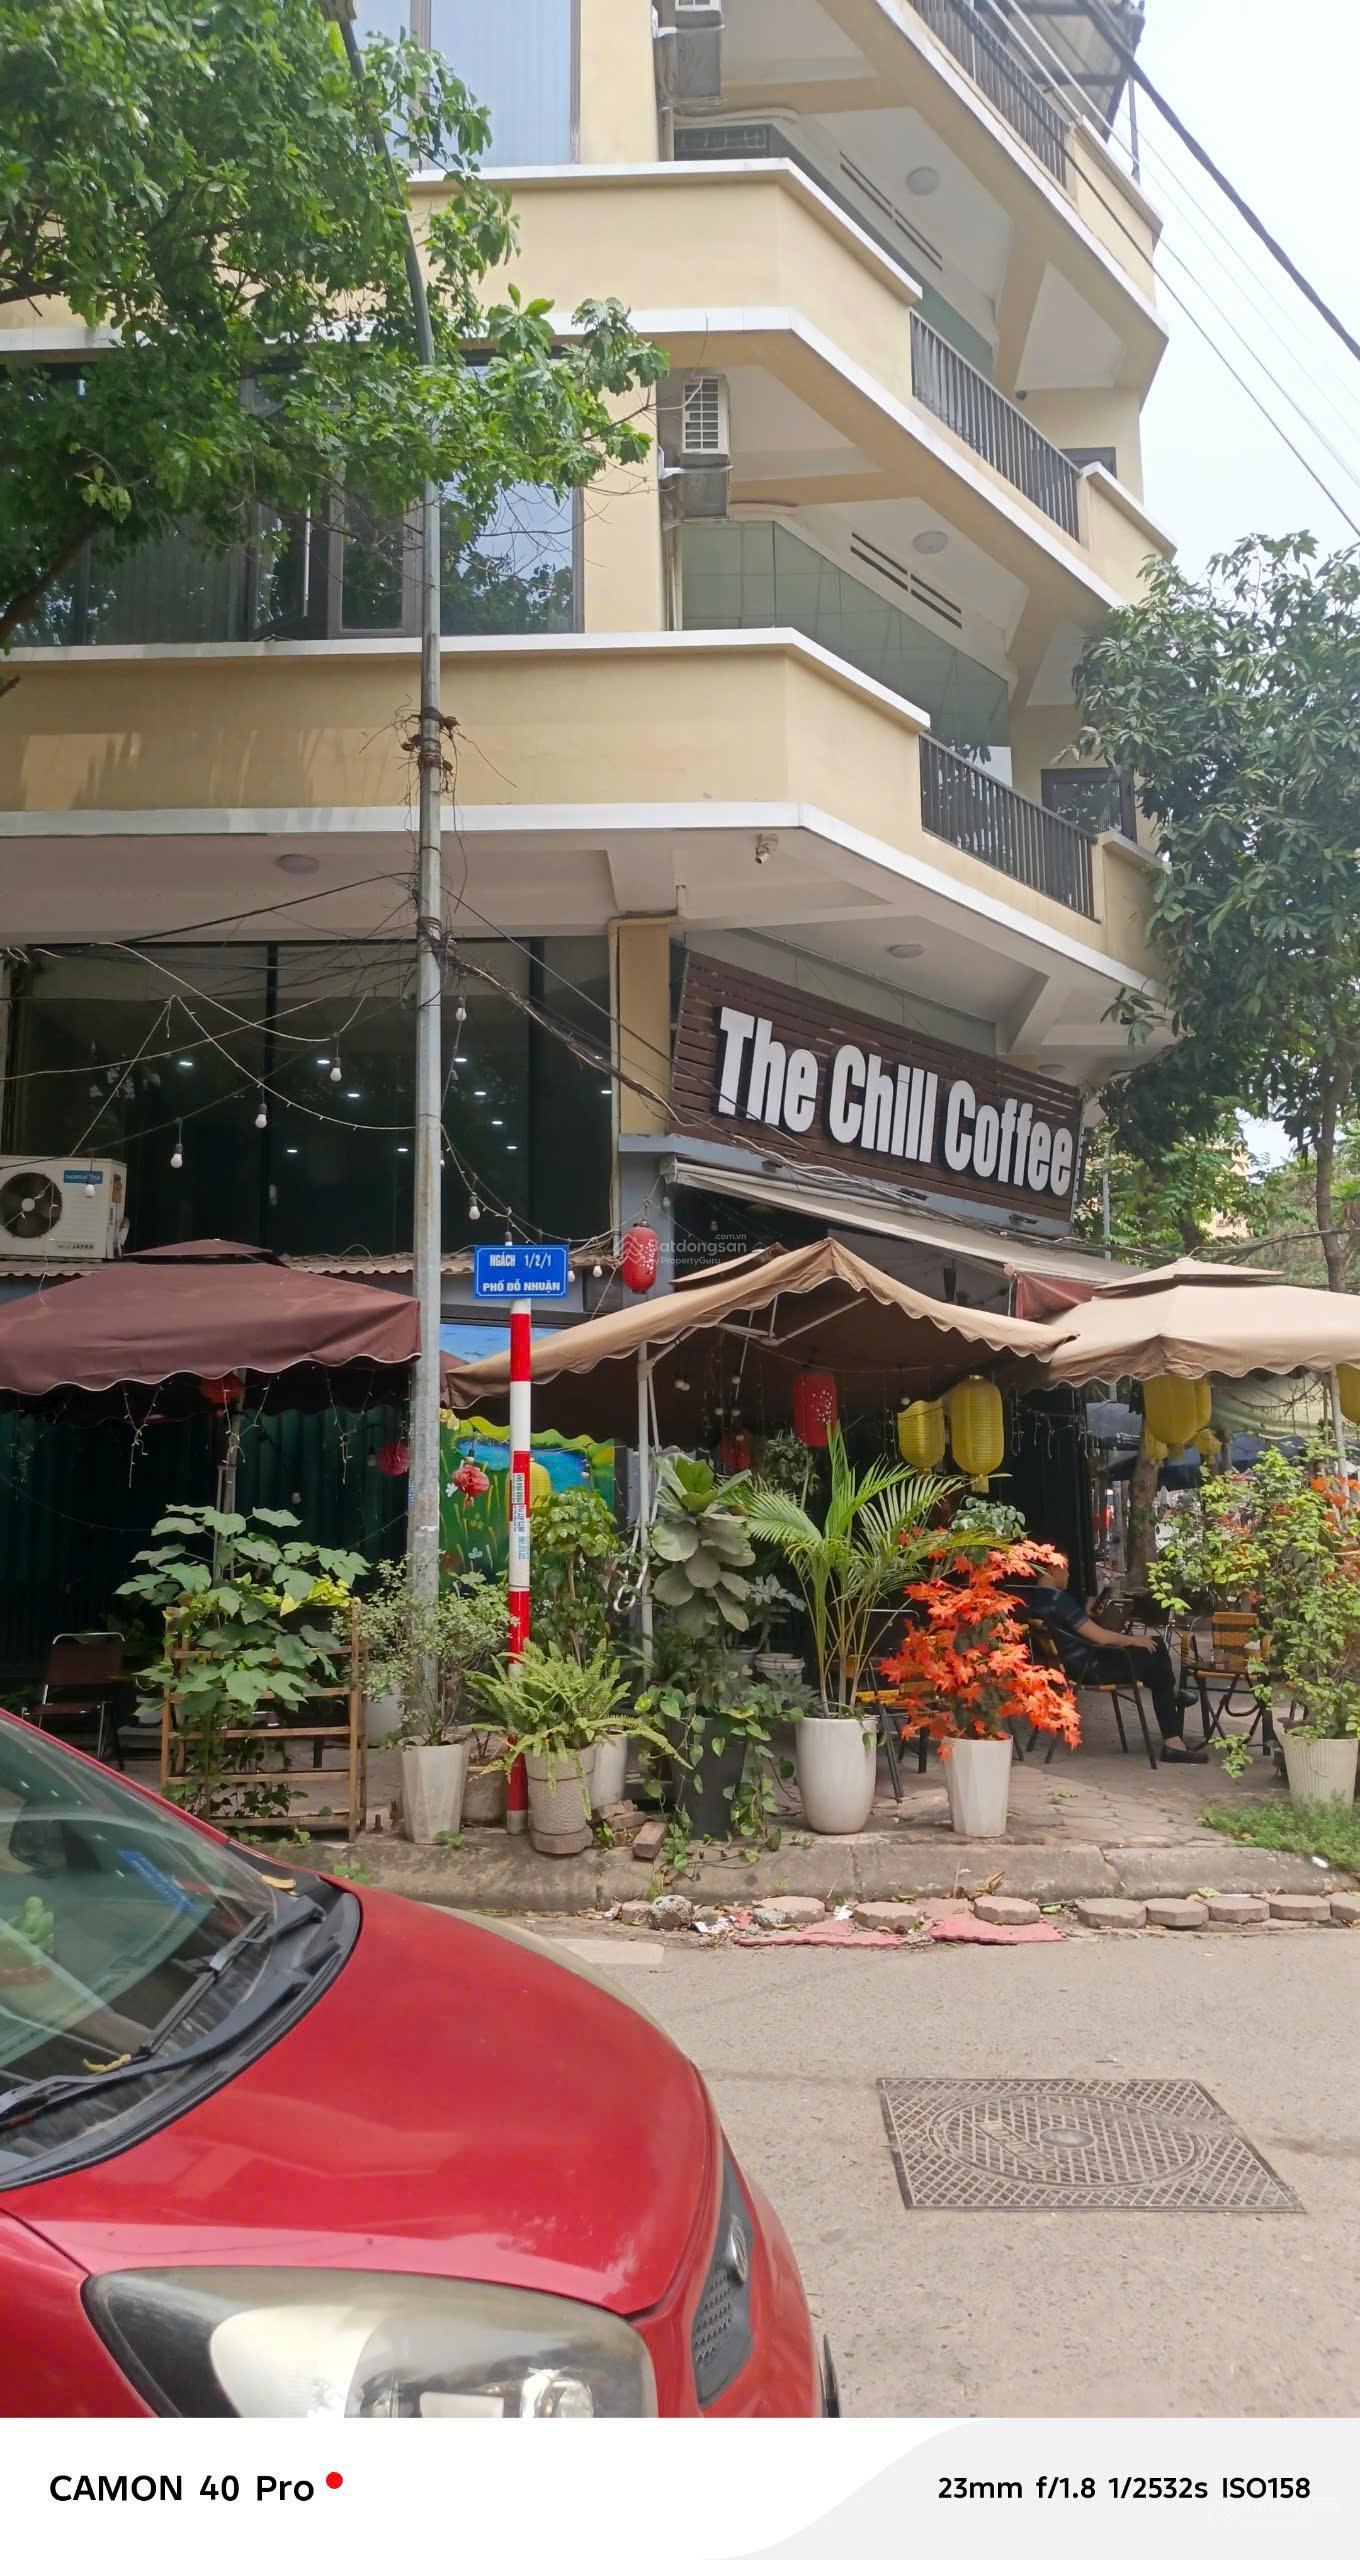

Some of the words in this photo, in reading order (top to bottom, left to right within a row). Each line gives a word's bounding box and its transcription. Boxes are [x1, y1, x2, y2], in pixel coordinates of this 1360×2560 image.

[718, 1006, 818, 1132] The
[829, 1044, 939, 1163] Chill
[944, 1080, 1073, 1196] Coffee
[489, 1251, 516, 1267] NGÁCH
[524, 1253, 552, 1269] 1/2/1
[482, 1279, 505, 1292] PHỐ
[523, 1280, 561, 1293] NHUẬN
